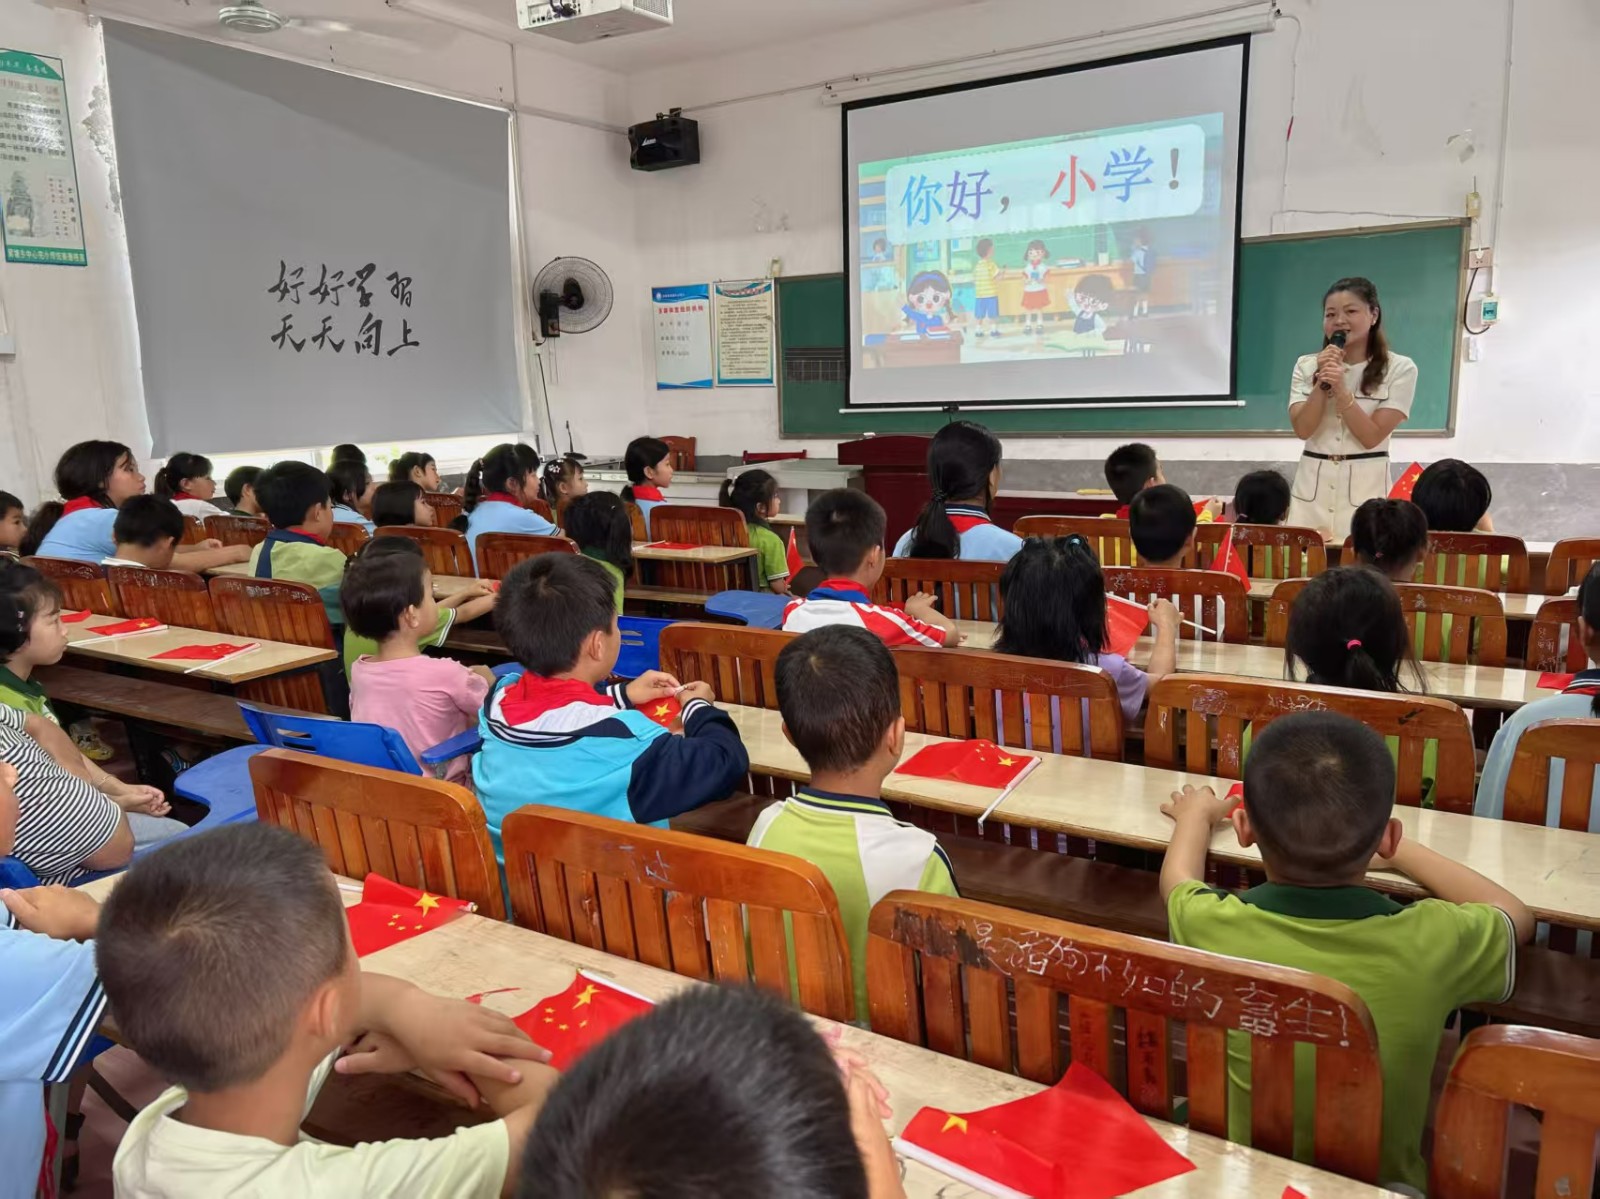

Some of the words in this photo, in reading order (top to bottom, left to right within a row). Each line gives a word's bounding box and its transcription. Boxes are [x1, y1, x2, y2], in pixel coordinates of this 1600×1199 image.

[900, 145, 1179, 227] 你好，小学！
[267, 259, 413, 308] 好好学习
[270, 312, 420, 357] 天天向上
